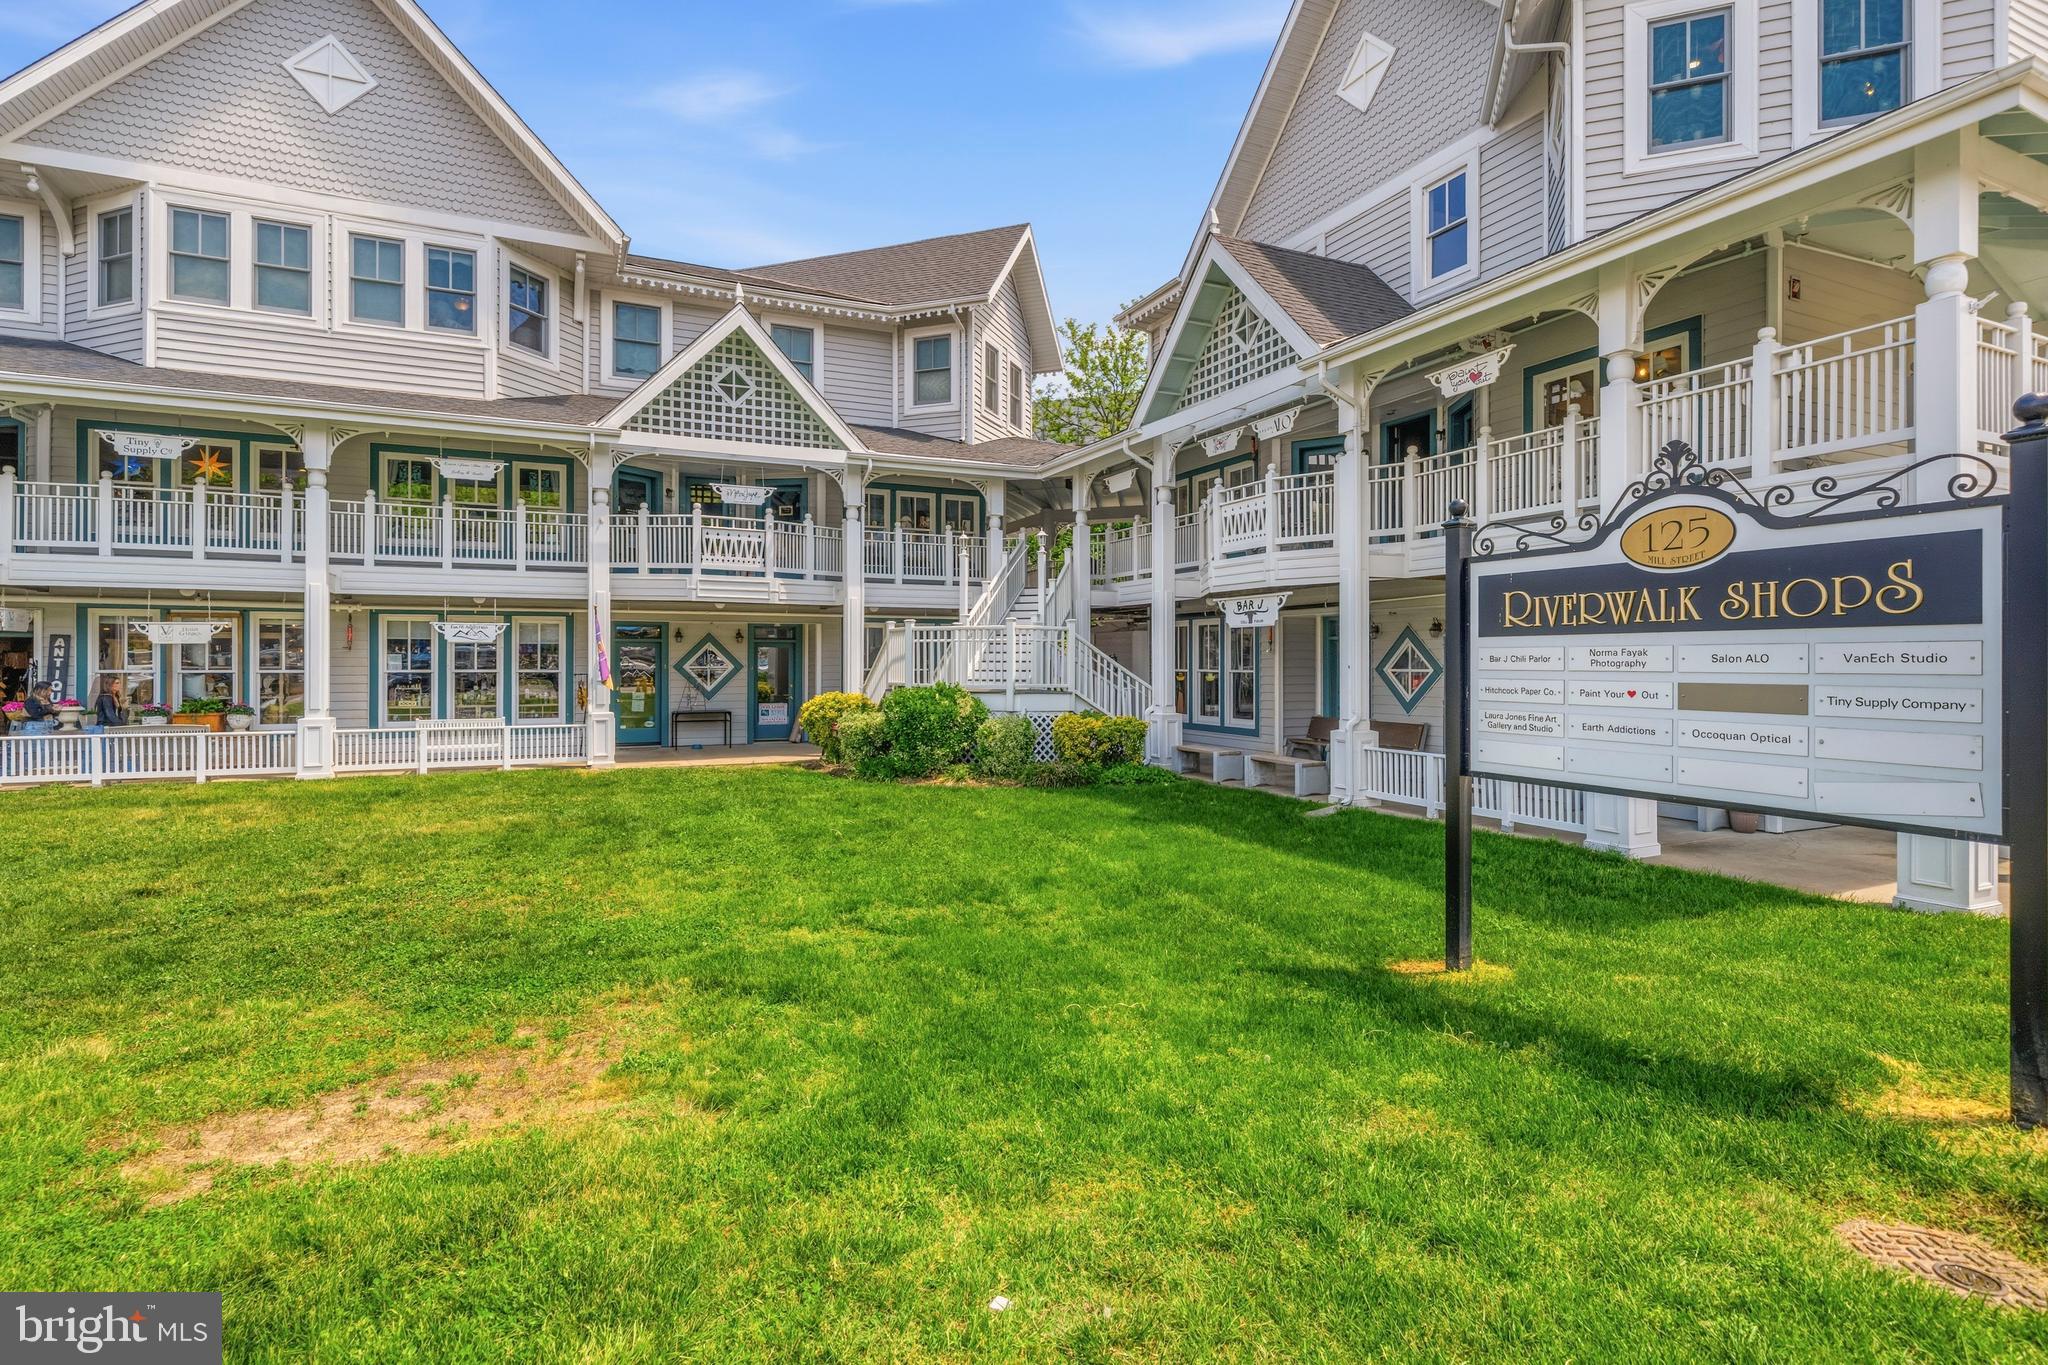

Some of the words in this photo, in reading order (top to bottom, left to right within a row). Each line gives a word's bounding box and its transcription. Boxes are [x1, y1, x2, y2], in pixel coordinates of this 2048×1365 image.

[126, 436, 149, 447] Tiny
[123, 445, 157, 455] Supply
[1642, 513, 1710, 553] 125
[1647, 554, 1667, 565] MILL
[1669, 550, 1706, 565] STREET
[1502, 585, 1703, 628] RIVERWALK
[1719, 558, 1926, 621] SHOPS
[1236, 600, 1254, 612] BAR
[1257, 599, 1264, 610] J
[1489, 655, 1501, 663] Bar
[1503, 655, 1508, 663] J
[1510, 655, 1527, 663] Chili
[1528, 655, 1551, 663] Parlor
[1589, 649, 1618, 658] Norma
[1621, 648, 1648, 660] Fayak
[1711, 653, 1742, 664] Salon
[1745, 653, 1770, 664] ALO
[1843, 652, 1895, 664] VanEch
[1900, 652, 1948, 664] Studio
[1590, 658, 1647, 669] Photography
[1484, 686, 1519, 696] Hitchcock
[1520, 687, 1542, 697] Paper
[1543, 688, 1557, 697] Co.
[1579, 688, 1601, 699] Paint
[1604, 689, 1625, 699] Your
[1641, 690, 1659, 701] Out
[1827, 696, 1852, 709] Tiny
[1855, 696, 1898, 711] Supply
[1901, 698, 1967, 713] Company
[1484, 712, 1504, 721] Laura
[1505, 713, 1527, 722] Jones
[1528, 714, 1544, 723] Fine
[1545, 715, 1557, 724] Art
[1487, 721, 1512, 732] Gallery
[1513, 724, 1527, 732] and
[1528, 723, 1554, 734] Studio
[1582, 722, 1604, 733] Earth
[1607, 724, 1656, 737] Addictions
[1692, 729, 1746, 743] Occoquan
[1750, 732, 1791, 746] Optical
